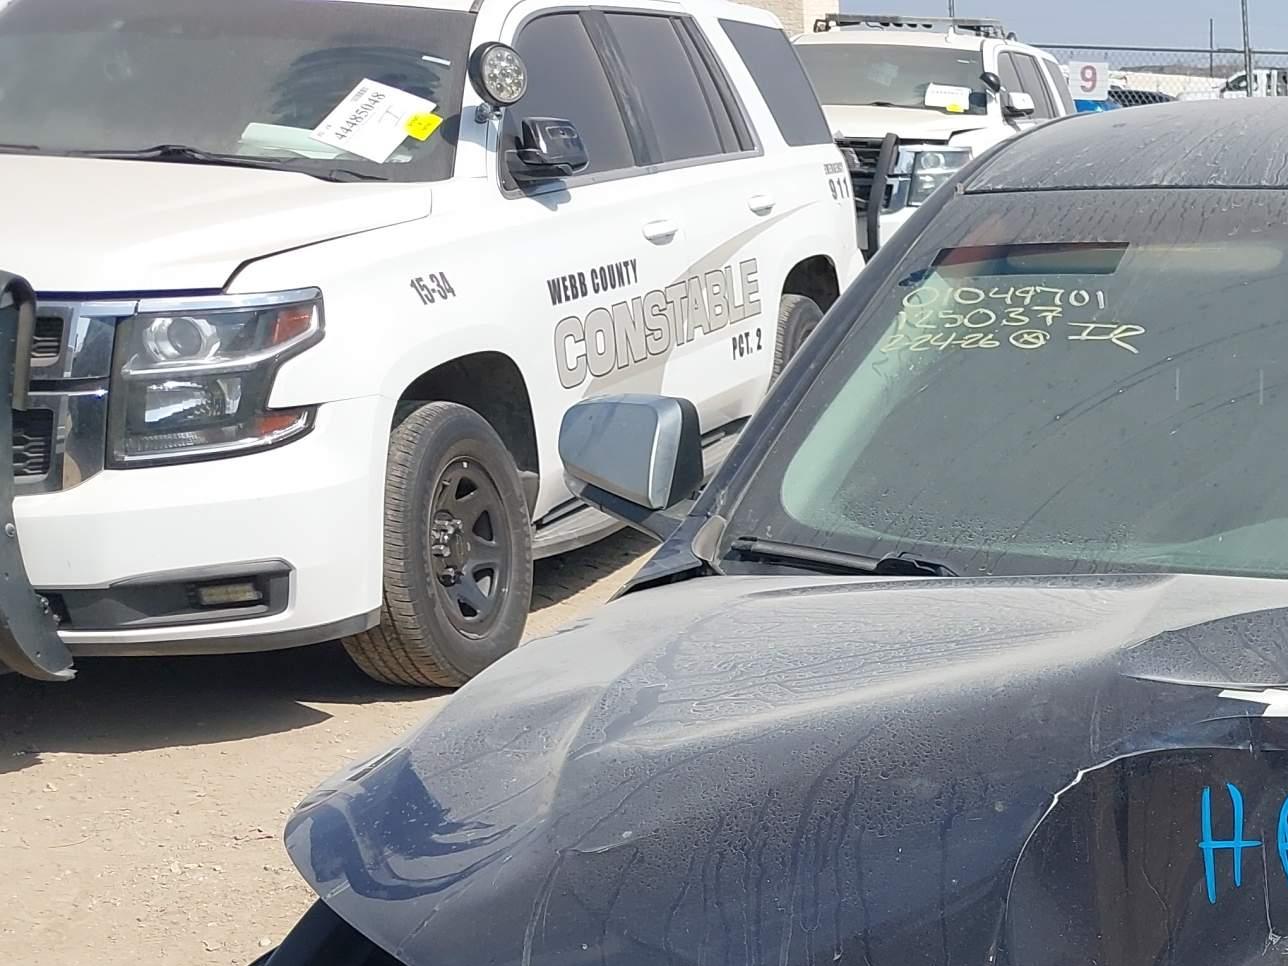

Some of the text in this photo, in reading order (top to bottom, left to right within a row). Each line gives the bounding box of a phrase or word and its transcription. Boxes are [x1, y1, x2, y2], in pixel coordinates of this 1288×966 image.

[1080, 65, 1097, 93] 9
[335, 91, 386, 141] 44485048
[829, 177, 849, 201] 911
[410, 271, 456, 305] 15-34
[547, 258, 640, 305] WEBB COUNTY
[553, 258, 763, 390] CONSTABLE
[732, 327, 763, 361] PCT. 2
